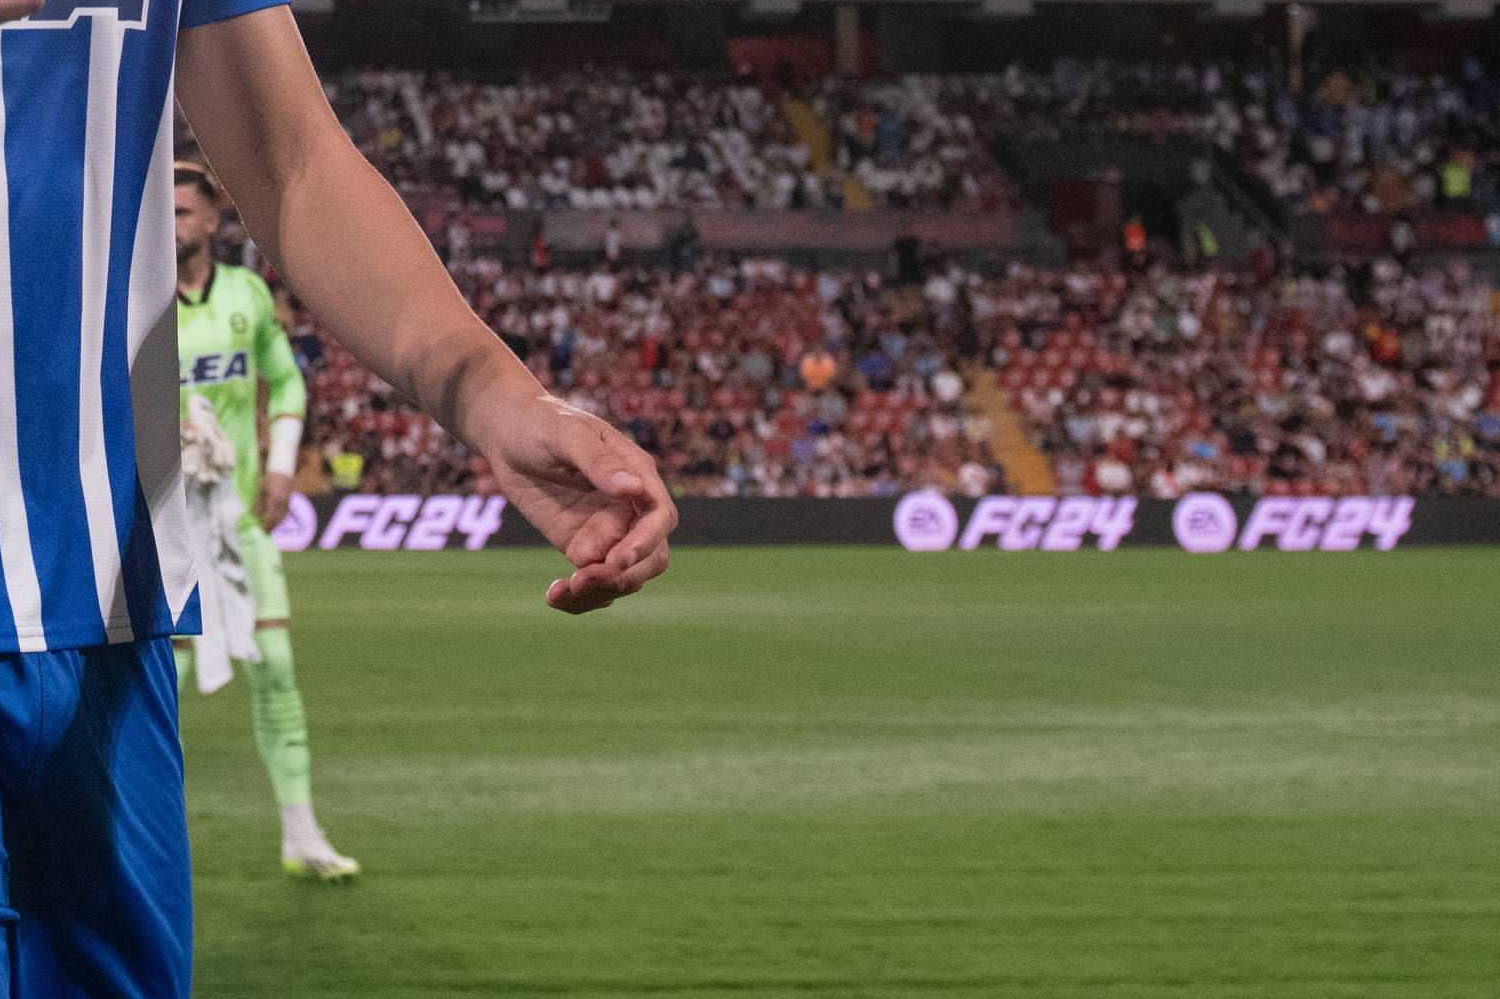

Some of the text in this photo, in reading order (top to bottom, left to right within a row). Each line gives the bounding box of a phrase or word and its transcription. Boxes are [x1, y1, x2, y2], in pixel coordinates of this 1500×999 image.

[318, 493, 508, 550] FC24
[958, 495, 1138, 551] FC24
[1238, 495, 1416, 551] FC24
